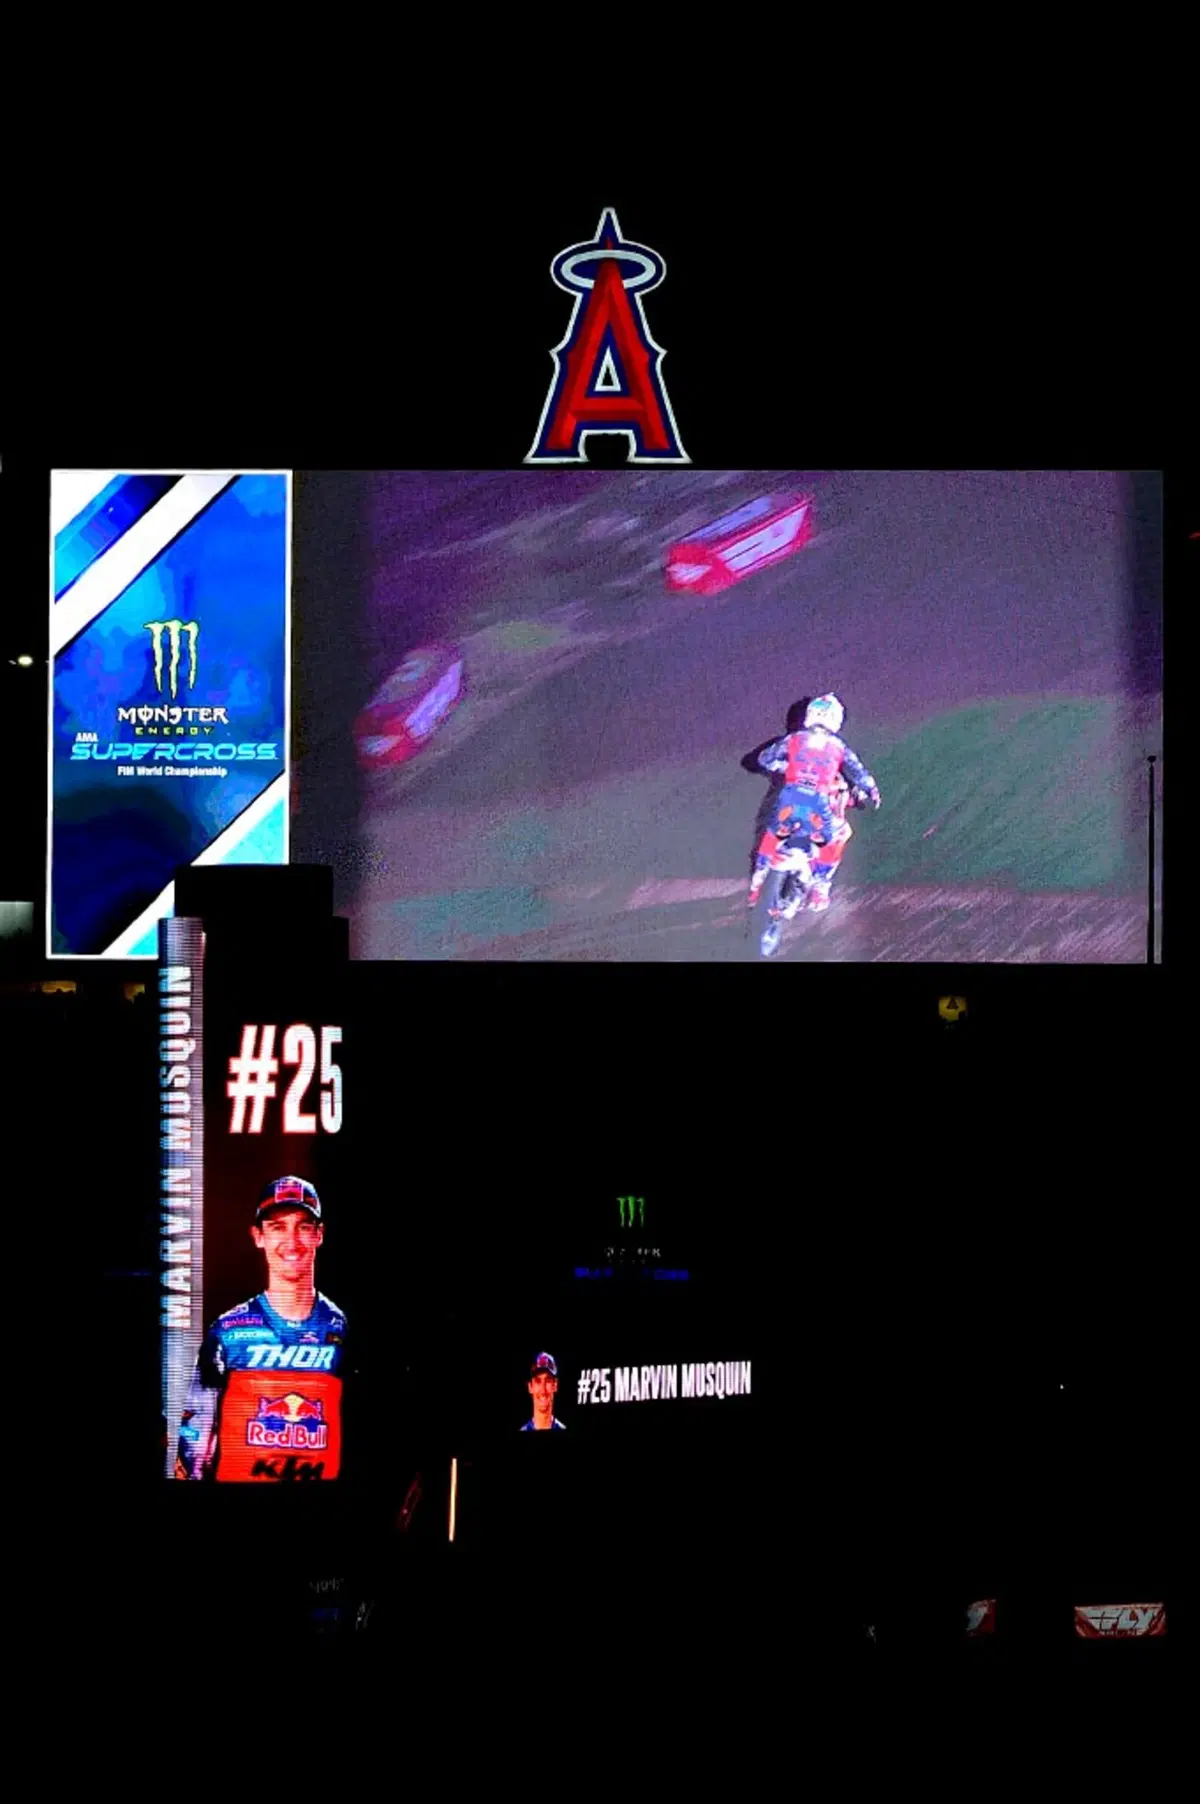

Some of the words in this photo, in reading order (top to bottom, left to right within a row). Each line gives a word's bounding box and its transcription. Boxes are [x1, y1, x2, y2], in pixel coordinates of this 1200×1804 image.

[117, 704, 229, 725] MONSTER
[75, 732, 99, 743] AMA
[135, 726, 214, 736] ENERGY
[70, 743, 279, 761] SUPERCROSS
[117, 766, 135, 776] FIM
[137, 765, 163, 776] World
[164, 765, 228, 778] Championship
[158, 966, 196, 1150] MUSQUIN
[226, 1023, 343, 1134] #25
[160, 1168, 192, 1328] MARVIN
[246, 1344, 336, 1369] THOR
[577, 1368, 611, 1405] #25
[614, 1364, 678, 1403] MARVIN
[681, 1360, 752, 1400] MUSQUIN
[247, 1421, 293, 1447] Red
[293, 1424, 327, 1449] Bull
